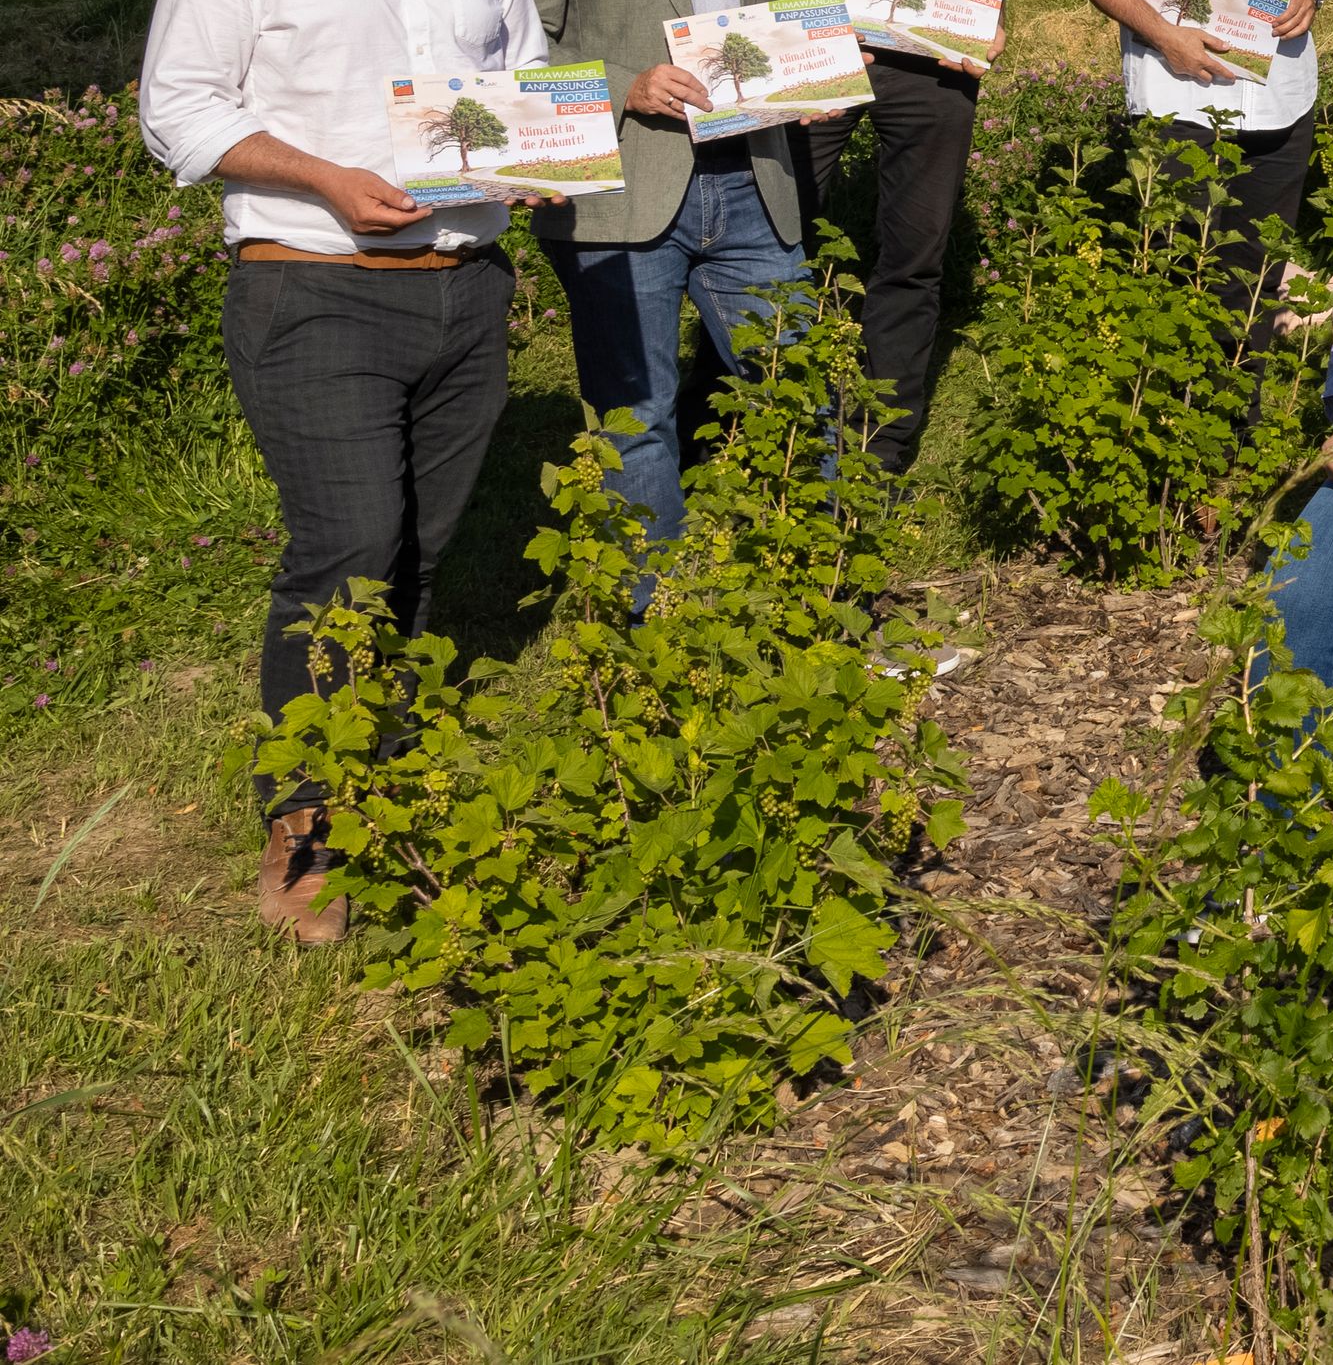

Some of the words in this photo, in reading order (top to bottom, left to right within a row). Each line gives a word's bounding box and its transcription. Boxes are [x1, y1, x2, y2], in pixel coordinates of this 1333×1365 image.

[779, 7, 844, 20] ANPASSUNGS-
[934, 0, 964, 14] Klimafit
[965, 7, 972, 15] in
[805, 18, 846, 29] MODELL-
[932, 11, 943, 20] die
[944, 13, 976, 27] Zukunft!
[811, 27, 848, 40] REGION
[1227, 27, 1258, 42] Zukunft!
[779, 48, 814, 64] Klimafit
[816, 46, 826, 56] in
[782, 64, 796, 76] die
[797, 57, 836, 74] Zukunft!
[518, 69, 602, 80] KLIMAWANDEL-
[525, 81, 603, 91] ANPASSUNGS-
[555, 92, 604, 102] MODELL-
[561, 103, 604, 114] REGION
[518, 124, 563, 138] Klimafit
[565, 123, 575, 133] in
[521, 139, 536, 151] die
[539, 134, 585, 150] Zukunft!
